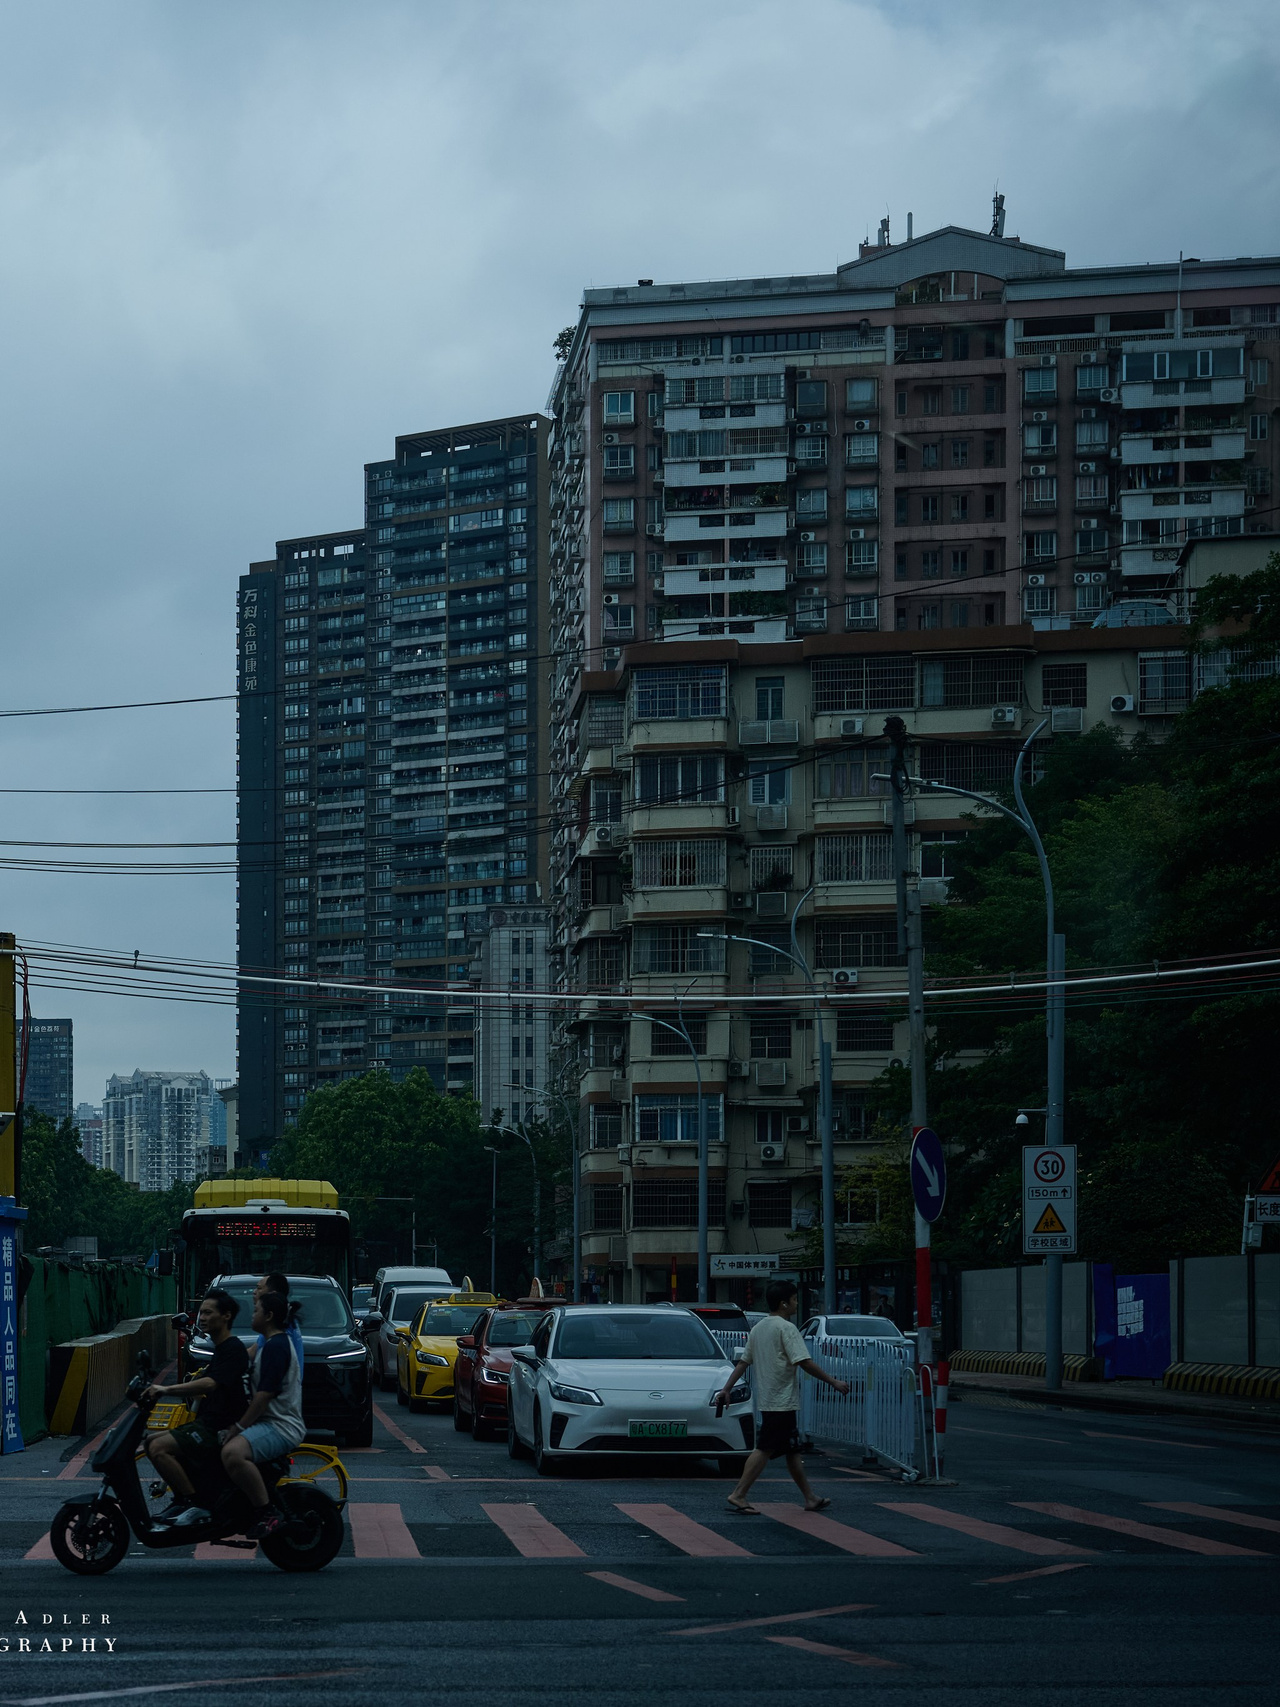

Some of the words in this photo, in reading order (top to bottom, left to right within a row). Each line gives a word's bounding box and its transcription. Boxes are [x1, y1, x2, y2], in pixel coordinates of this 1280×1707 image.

[1041, 1160, 1059, 1175] 30
[1031, 1189, 1058, 1197] 150m
[1257, 1202, 1280, 1216] 长度
[1031, 1238, 1069, 1247] 学校区域
[728, 1261, 776, 1269] 中国体育彩票
[2, 1236, 17, 1440] 精品人品同在
[649, 1423, 686, 1435] CX8177
